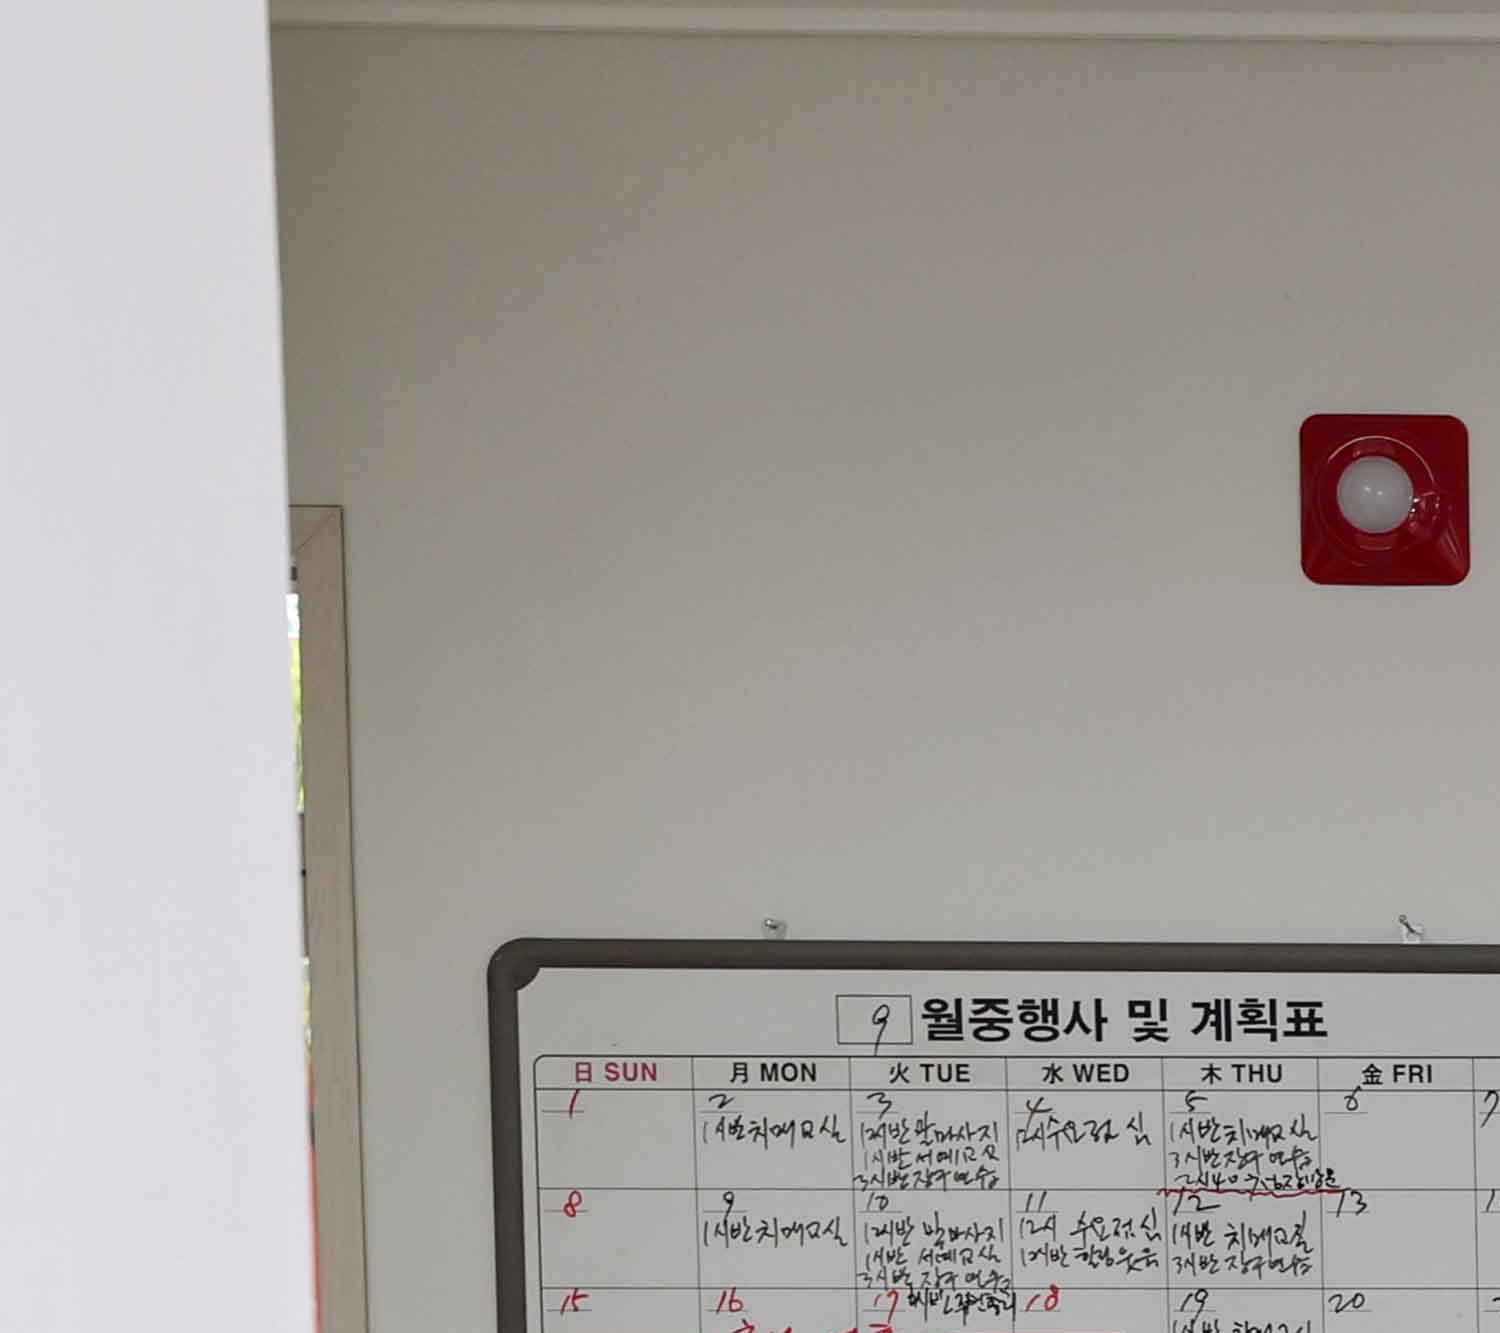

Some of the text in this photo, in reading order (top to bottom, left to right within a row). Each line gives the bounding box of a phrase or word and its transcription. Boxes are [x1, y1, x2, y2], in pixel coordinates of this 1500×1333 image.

[871, 1003, 890, 1056] 9
[921, 997, 1329, 1043] 월중행사 및 계획표
[575, 1062, 658, 1083] 日 SUN
[729, 1062, 817, 1084] 月 MON
[888, 1063, 971, 1085] 火 TUE
[1042, 1063, 1131, 1085] 水 WED
[1201, 1064, 1283, 1085] 木 THU
[1361, 1063, 1433, 1085] 金 FRI
[708, 1093, 735, 1110] 2
[866, 1092, 893, 1119] 3
[1185, 1089, 1209, 1113] 5
[1480, 1090, 1500, 1128] 7
[562, 1190, 583, 1218] 8
[723, 1191, 735, 1214] 9
[866, 1191, 890, 1212] 10
[1025, 1189, 1048, 1212] 11
[1173, 1186, 1221, 1216] 12
[1336, 1188, 1368, 1218] 13
[559, 1288, 591, 1313] 15
[715, 1288, 744, 1313] 16
[1024, 1283, 1061, 1313] 18
[1179, 1287, 1210, 1319] 19
[1328, 1292, 1366, 1313] 20
